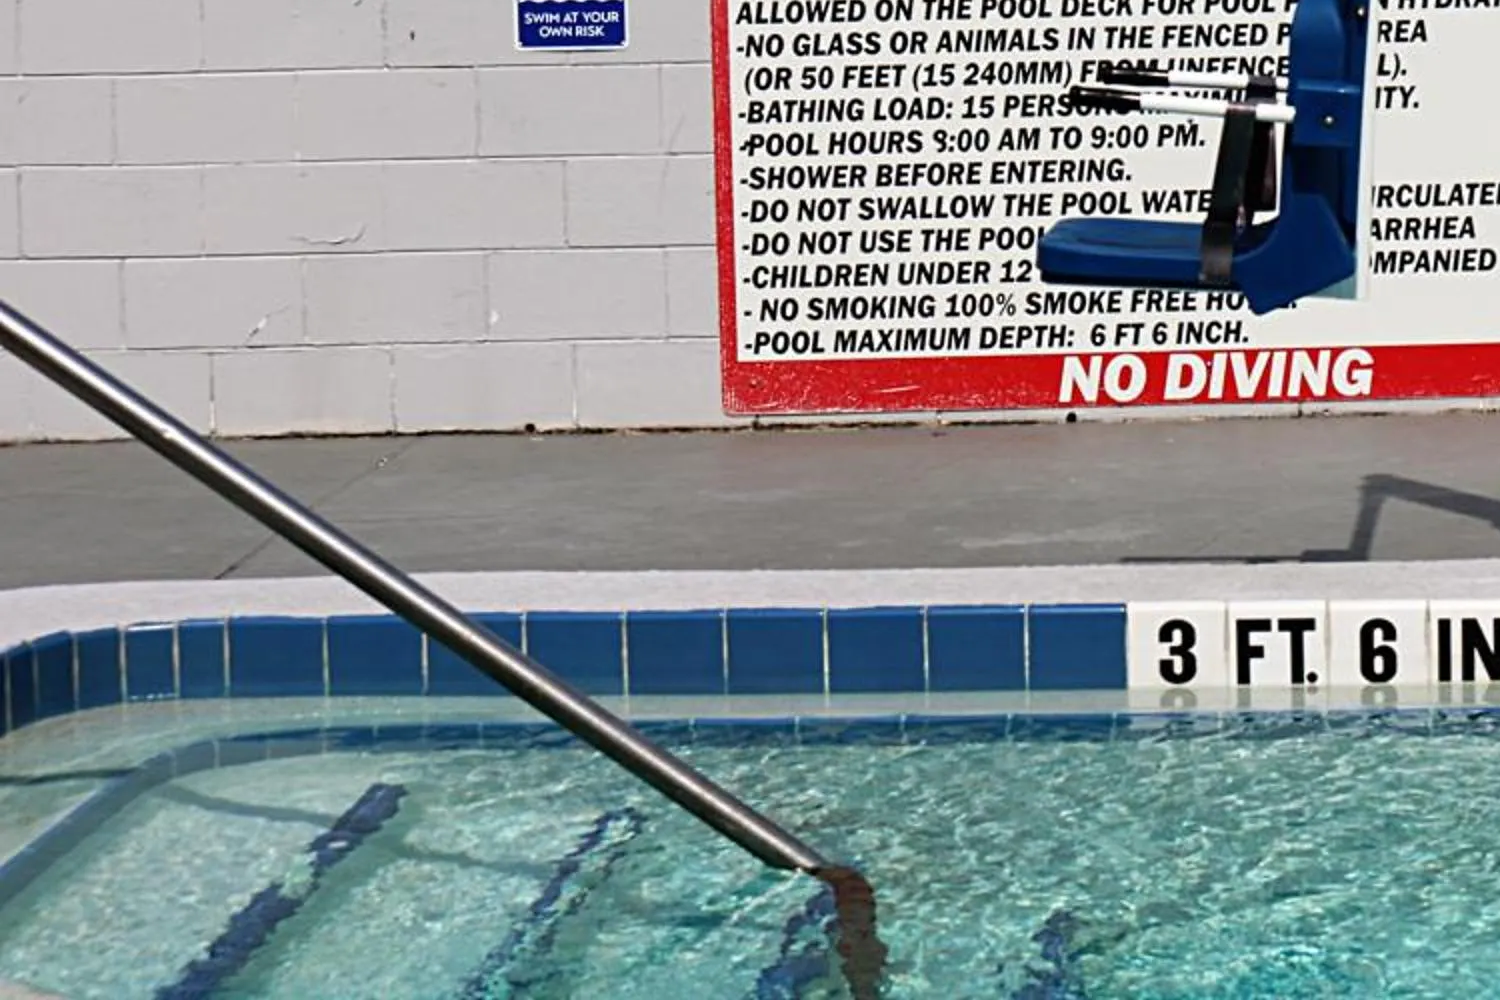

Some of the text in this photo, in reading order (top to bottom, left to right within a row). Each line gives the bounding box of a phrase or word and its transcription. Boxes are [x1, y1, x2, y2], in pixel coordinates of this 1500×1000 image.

[524, 11, 620, 24] SWIM AT YOUR
[735, 0, 867, 25] ALLOWED
[539, 25, 605, 37] OWN RISK
[792, 31, 881, 57] GLASS
[889, 30, 928, 55] OR
[935, 27, 1059, 53] ANIMALS
[1067, 27, 1096, 51] IN
[1104, 25, 1155, 49] THE
[1161, 23, 1269, 49] FENCED
[1377, 19, 1427, 43] REA
[744, 67, 793, 96] (OR
[801, 65, 834, 90] 50
[842, 64, 907, 89] FEET
[912, 63, 955, 92] (15
[963, 61, 1073, 89] 240MM)
[873, 97, 953, 121] LOAD:
[961, 95, 995, 119] 15
[827, 130, 923, 155] HOURS
[997, 127, 1041, 151] AM
[1049, 126, 1083, 150] TO
[1091, 124, 1149, 149] 9:00
[1157, 123, 1205, 148] PM.
[875, 161, 983, 187] BEFORE
[990, 158, 1132, 185] ENTERING.
[797, 197, 852, 222] NOT
[858, 194, 995, 221] SWALLOW
[1003, 193, 1054, 217] THE
[1061, 191, 1133, 216] POOL
[1141, 189, 1213, 214] WATE
[797, 231, 853, 255] NOT
[859, 229, 913, 254] USE
[920, 228, 971, 253] THE
[897, 261, 991, 286] UNDER
[999, 259, 1033, 283] 12
[759, 297, 799, 322] NO
[806, 294, 936, 321] SMOKING
[944, 293, 1017, 318] 100%
[1025, 290, 1123, 316] SMOKE
[1131, 291, 1198, 314] FREE
[833, 327, 971, 353] MAXIMUM
[979, 324, 1075, 350] DEPTH:
[1090, 323, 1106, 347] 6
[1114, 322, 1145, 346] FT
[1151, 321, 1168, 345] 6
[1176, 320, 1249, 345] INCH.
[1058, 348, 1374, 403] NO DIVING
[1158, 618, 1197, 685] 3
[1235, 617, 1319, 685] FT.
[1359, 617, 1398, 684] 6
